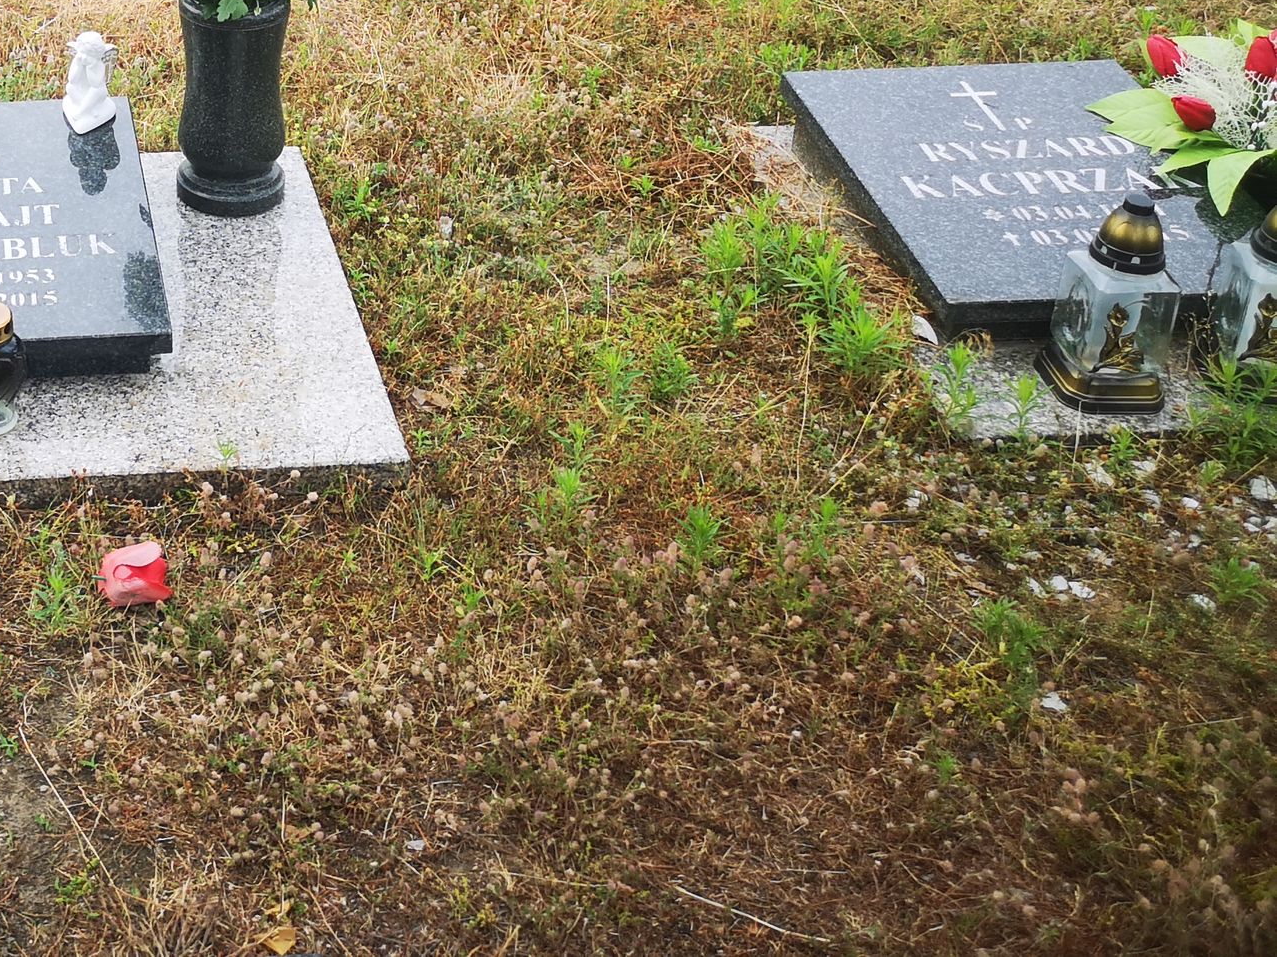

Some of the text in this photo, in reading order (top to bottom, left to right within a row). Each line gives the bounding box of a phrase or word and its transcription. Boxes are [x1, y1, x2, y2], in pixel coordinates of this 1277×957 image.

[1014, 116, 1032, 130] P
[918, 135, 1135, 163] RYSZARD
[900, 166, 1204, 200] KACPRZAK
